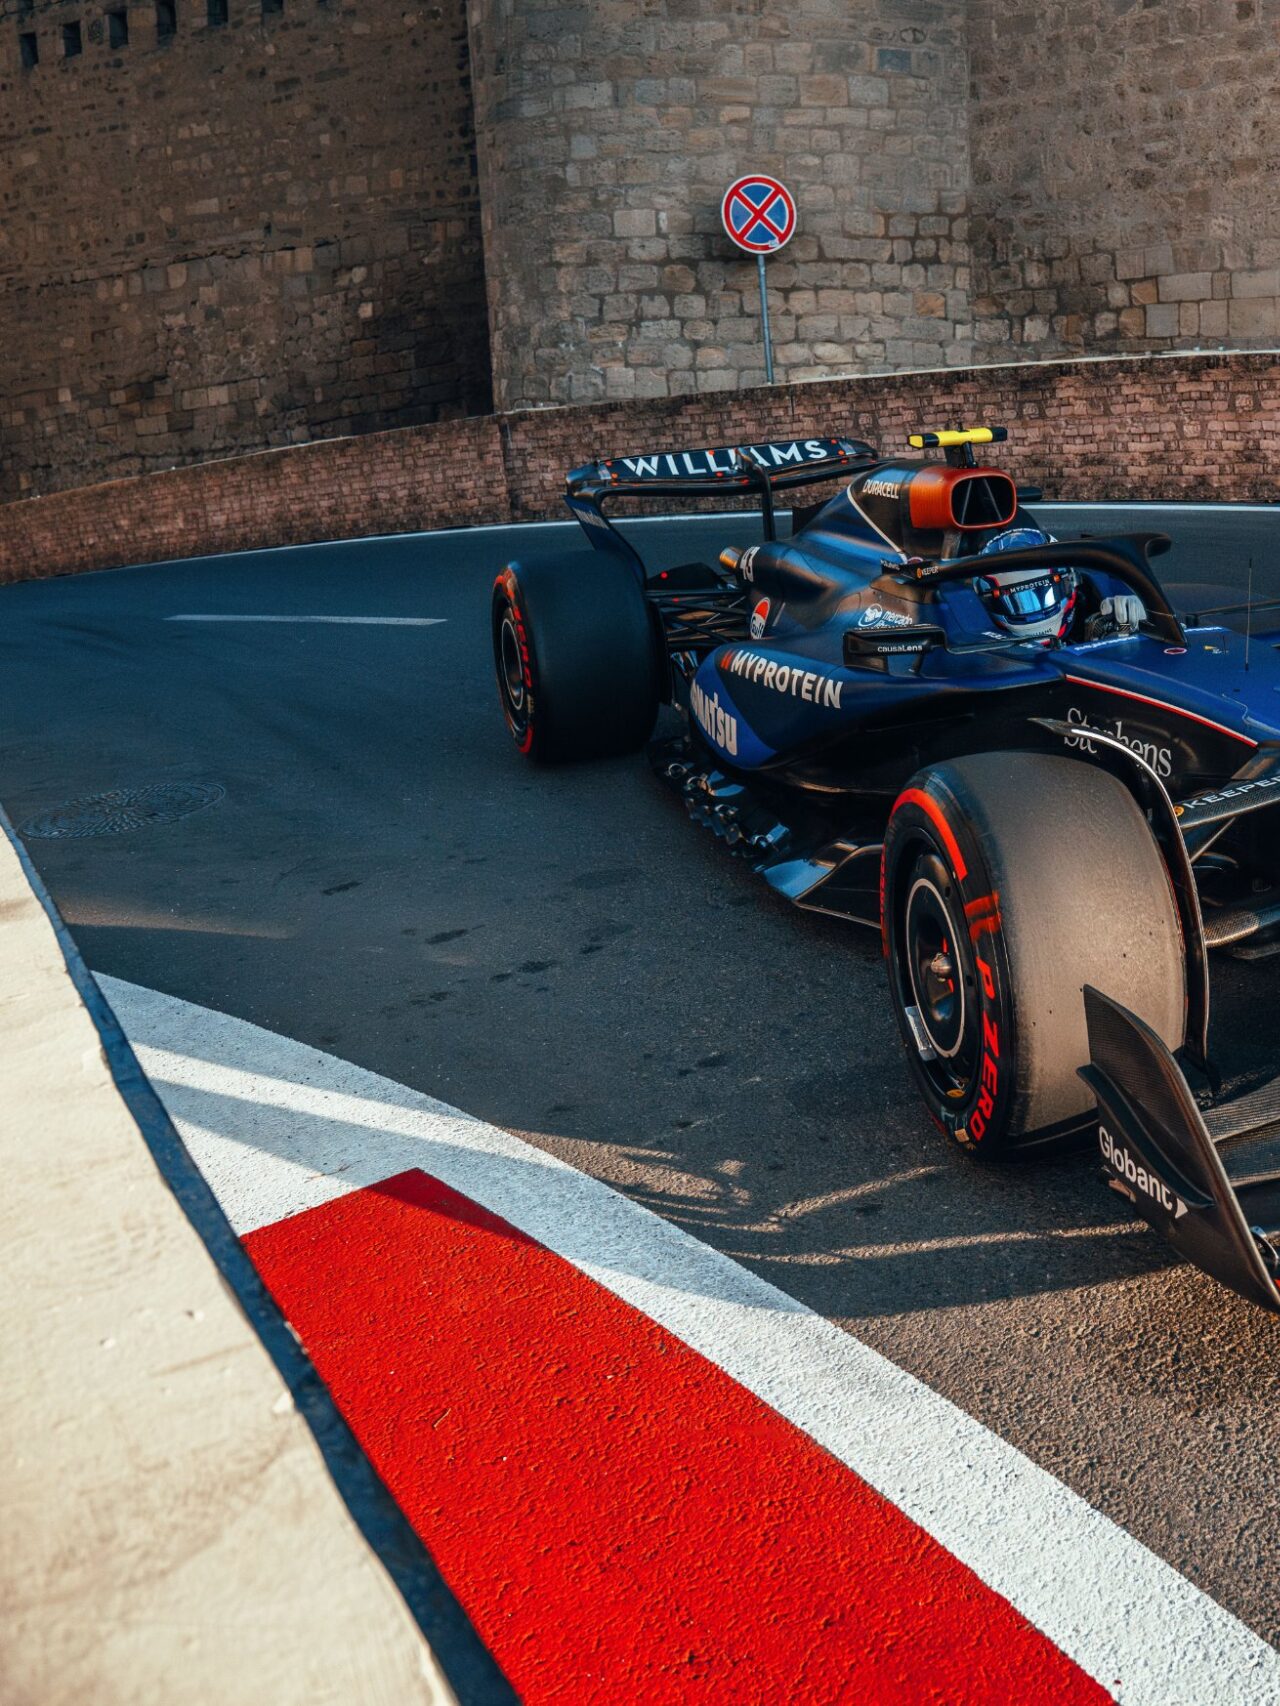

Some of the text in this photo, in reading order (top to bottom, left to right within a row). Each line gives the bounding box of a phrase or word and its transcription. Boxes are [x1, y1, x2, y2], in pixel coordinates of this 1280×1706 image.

[862, 478, 899, 499] DURACELL
[730, 650, 843, 709] MYPROTEIN
[969, 1010, 999, 1141] ZERO
[1099, 1126, 1173, 1211] Globant
